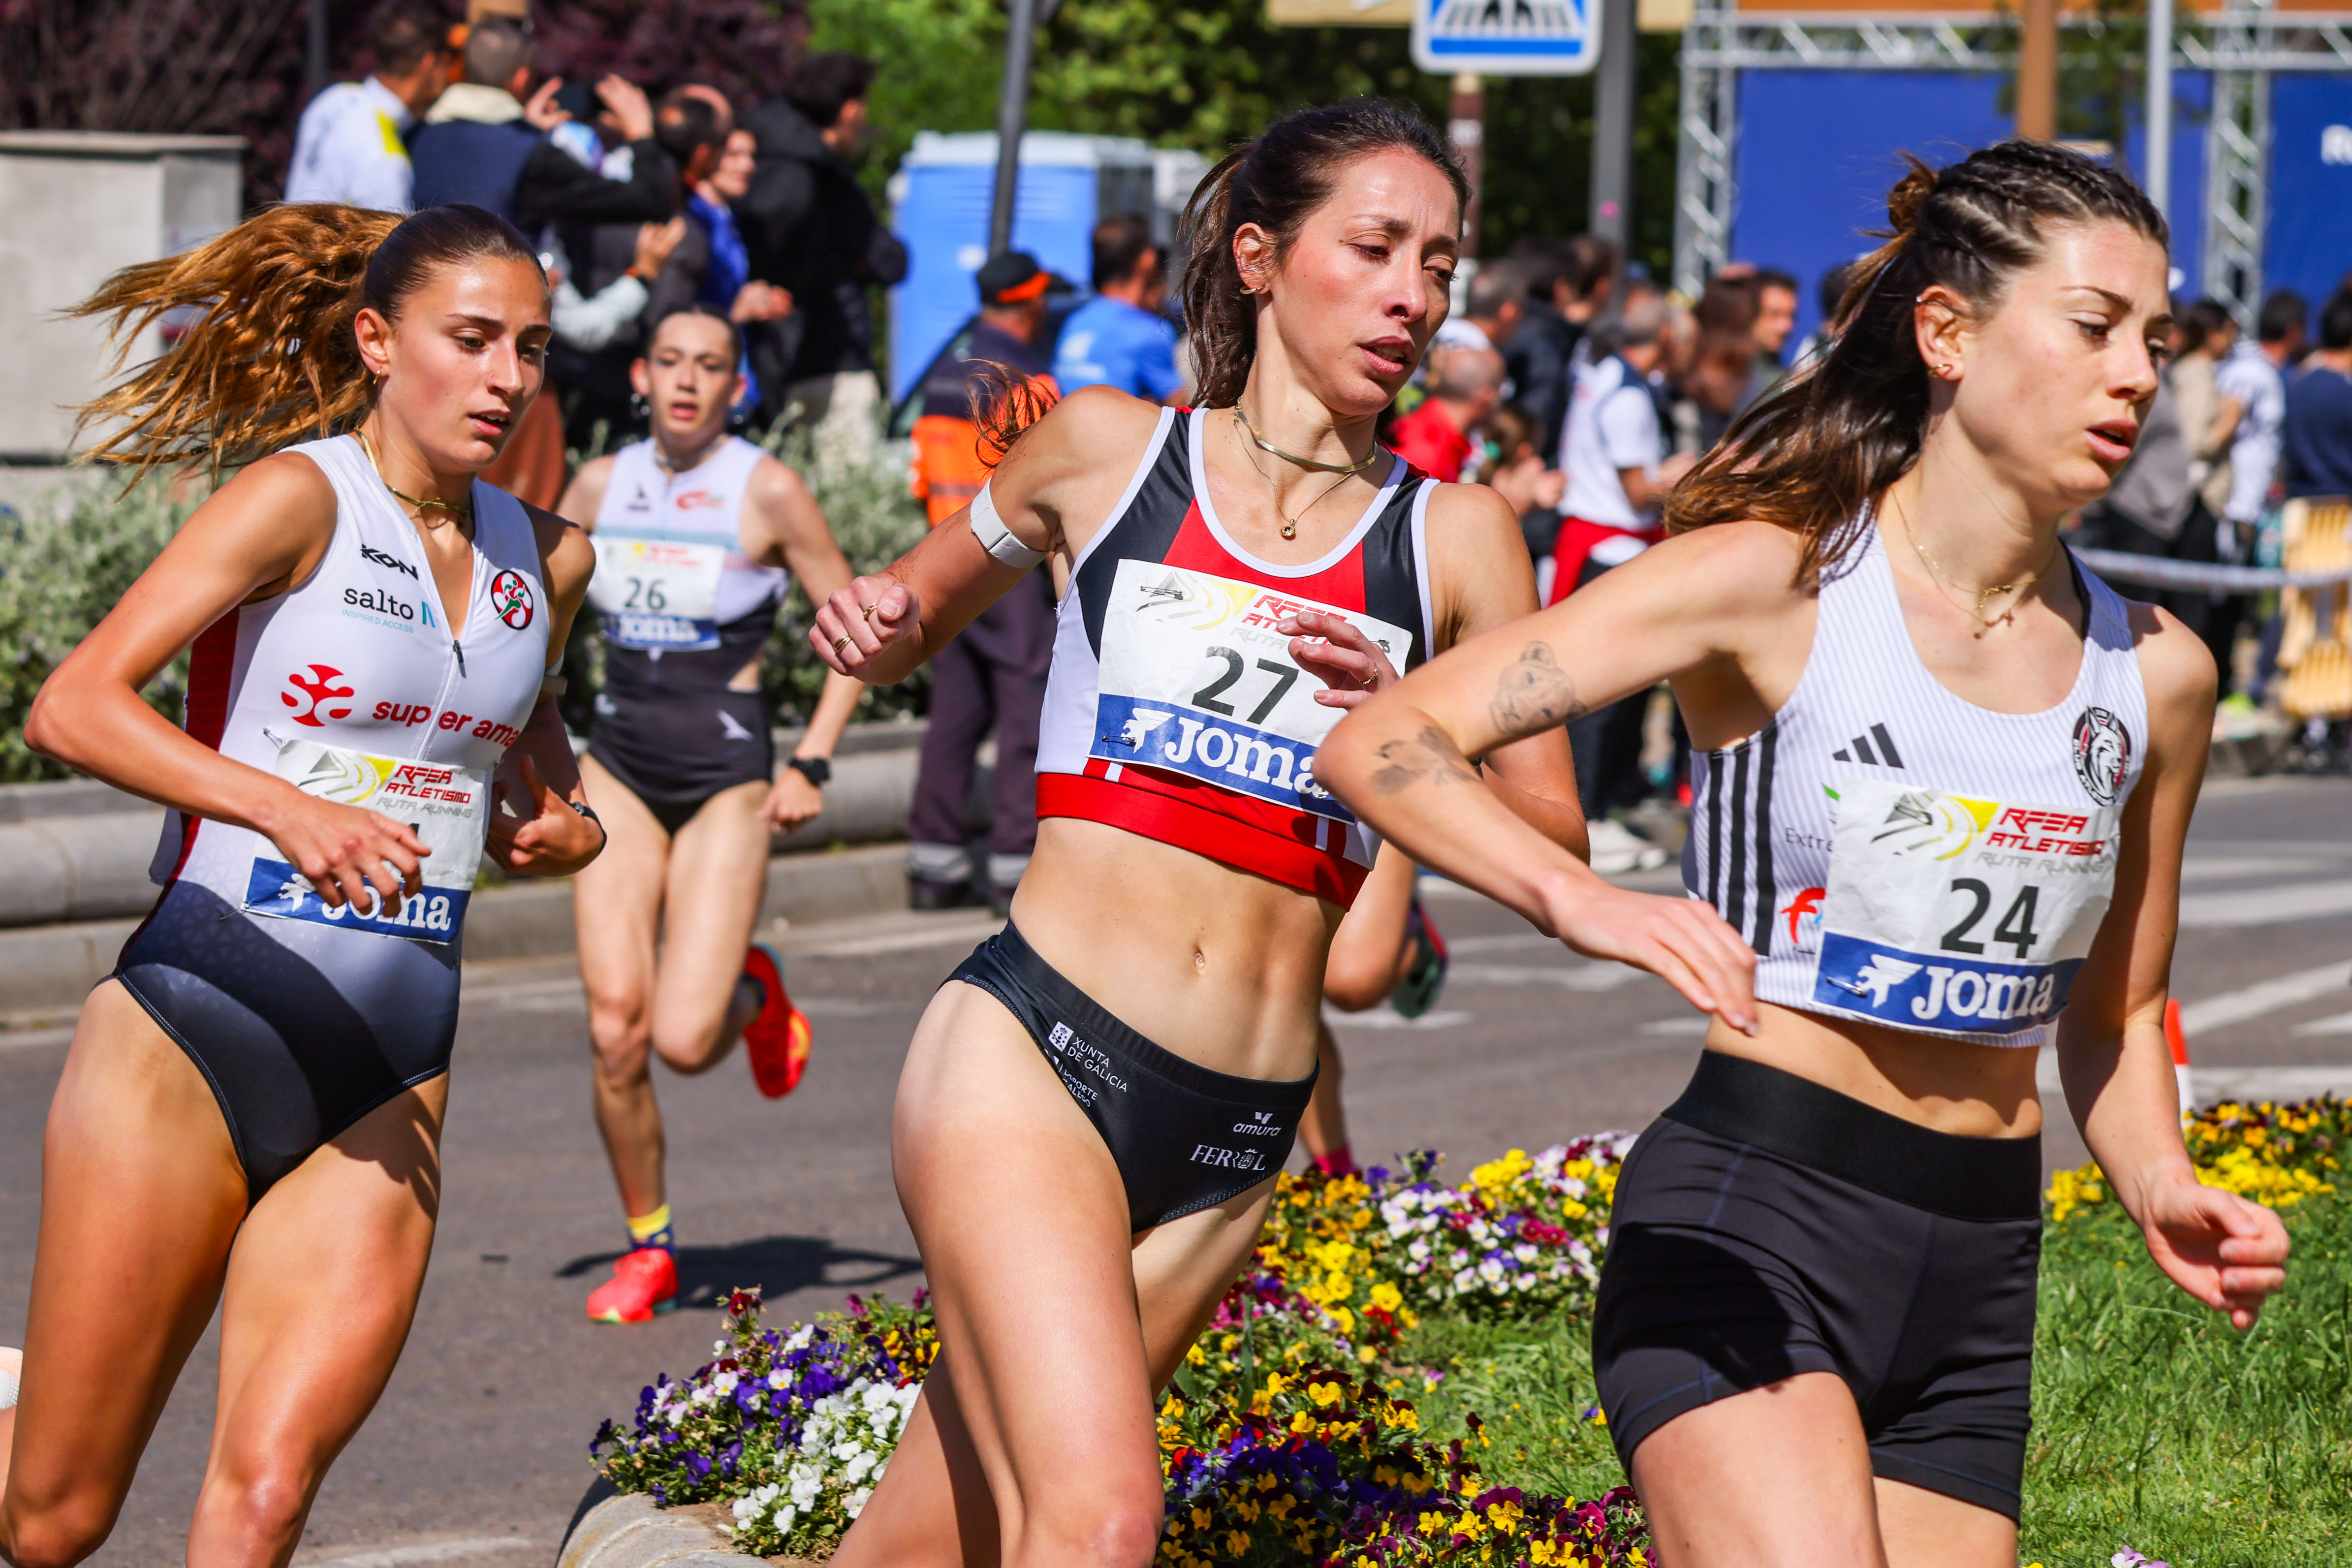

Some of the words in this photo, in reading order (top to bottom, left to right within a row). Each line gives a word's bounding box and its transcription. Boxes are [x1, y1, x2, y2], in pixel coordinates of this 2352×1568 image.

[344, 588, 414, 620] salto
[624, 577, 666, 610] 26
[342, 609, 381, 625] INSPIRED
[382, 619, 414, 634] ACCESS
[1253, 594, 1348, 623] RF
[1191, 646, 1299, 725] 27
[394, 764, 453, 784] RFEA
[376, 797, 418, 811] RUTA
[421, 803, 473, 818] RUNNING
[384, 782, 471, 804] ATLETISMO
[1998, 808, 2089, 834] RFEA
[1975, 851, 2033, 869] RUTA
[1940, 878, 2040, 960] 24
[1911, 965, 2055, 1020] Joma
[1072, 1036, 1110, 1068] XUNTA
[1067, 1046, 1084, 1062] DE
[1084, 1059, 1128, 1093] GALICIA
[1233, 1123, 1282, 1136] amura
